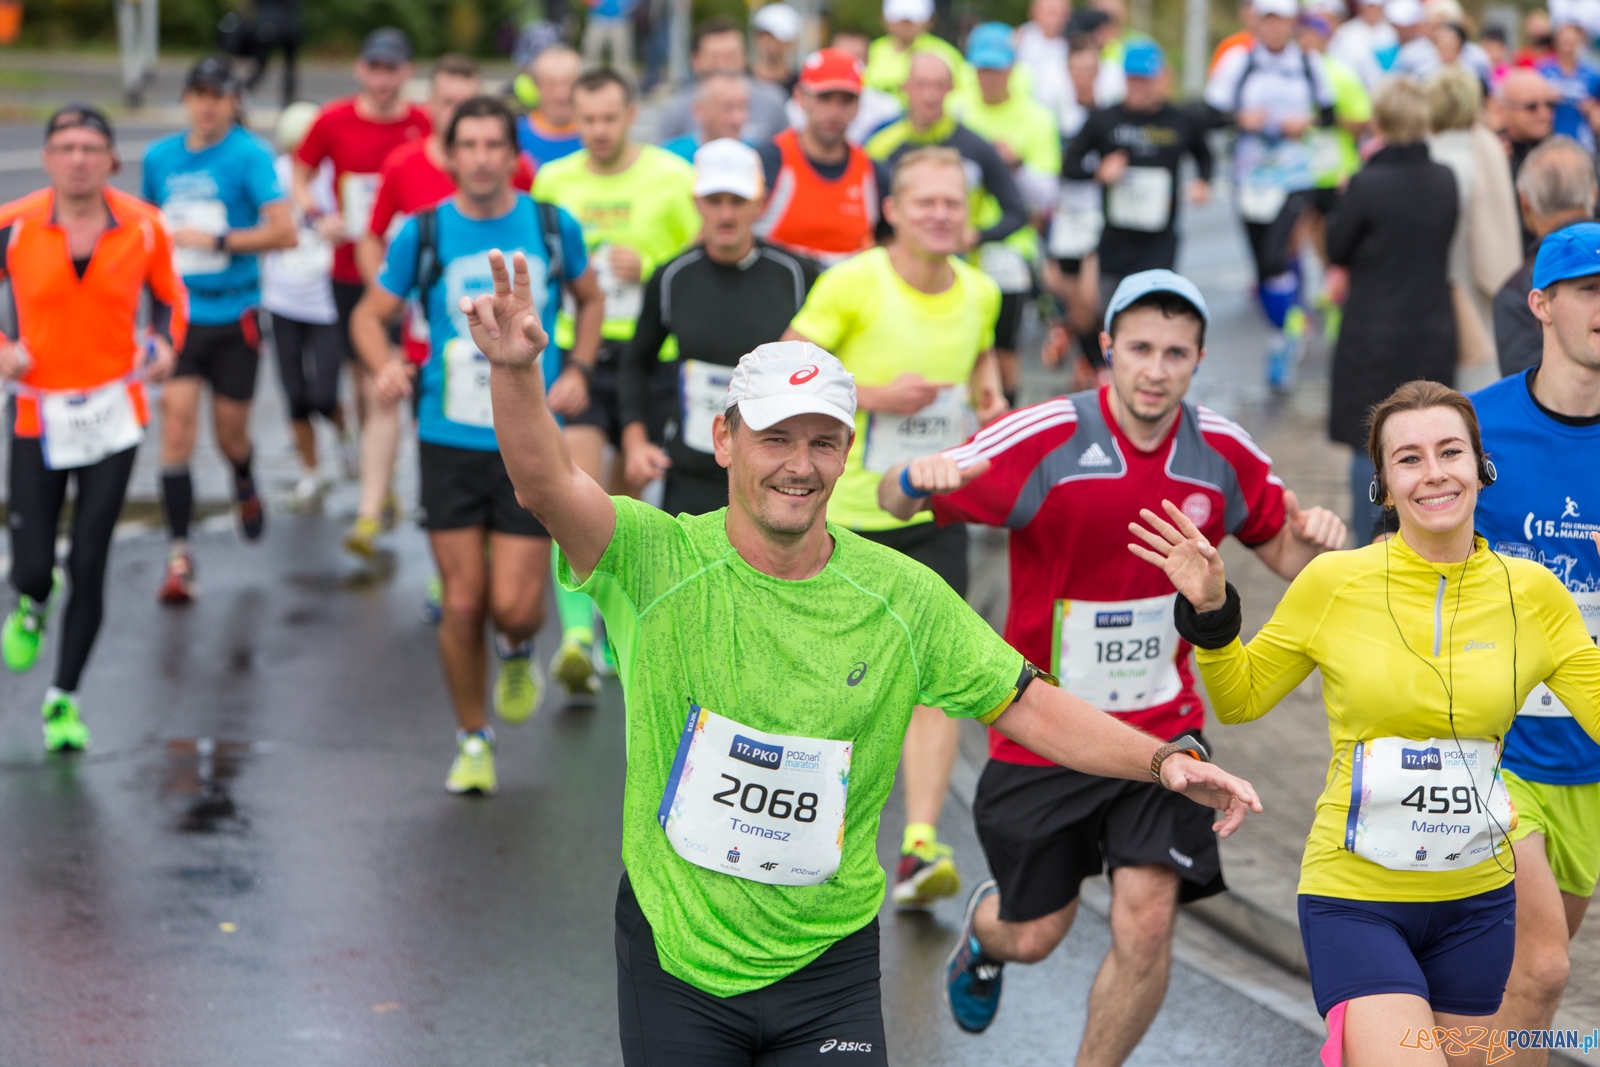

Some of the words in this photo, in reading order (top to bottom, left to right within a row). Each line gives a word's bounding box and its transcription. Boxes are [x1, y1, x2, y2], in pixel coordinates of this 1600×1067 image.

[1094, 636, 1162, 664] 1828
[735, 742, 751, 757] 17.
[752, 747, 779, 763] PKO
[1405, 754, 1420, 766] 17.
[1421, 753, 1439, 765] PKO
[784, 759, 820, 770] maraton
[1445, 758, 1478, 767] maraton
[712, 773, 819, 824] 2068
[1400, 785, 1482, 814] 4591
[730, 817, 791, 842] Tomasz
[1411, 820, 1471, 836] Martyna
[1445, 852, 1461, 861] 4F
[759, 861, 779, 872] 4F
[837, 1041, 873, 1053] asics
